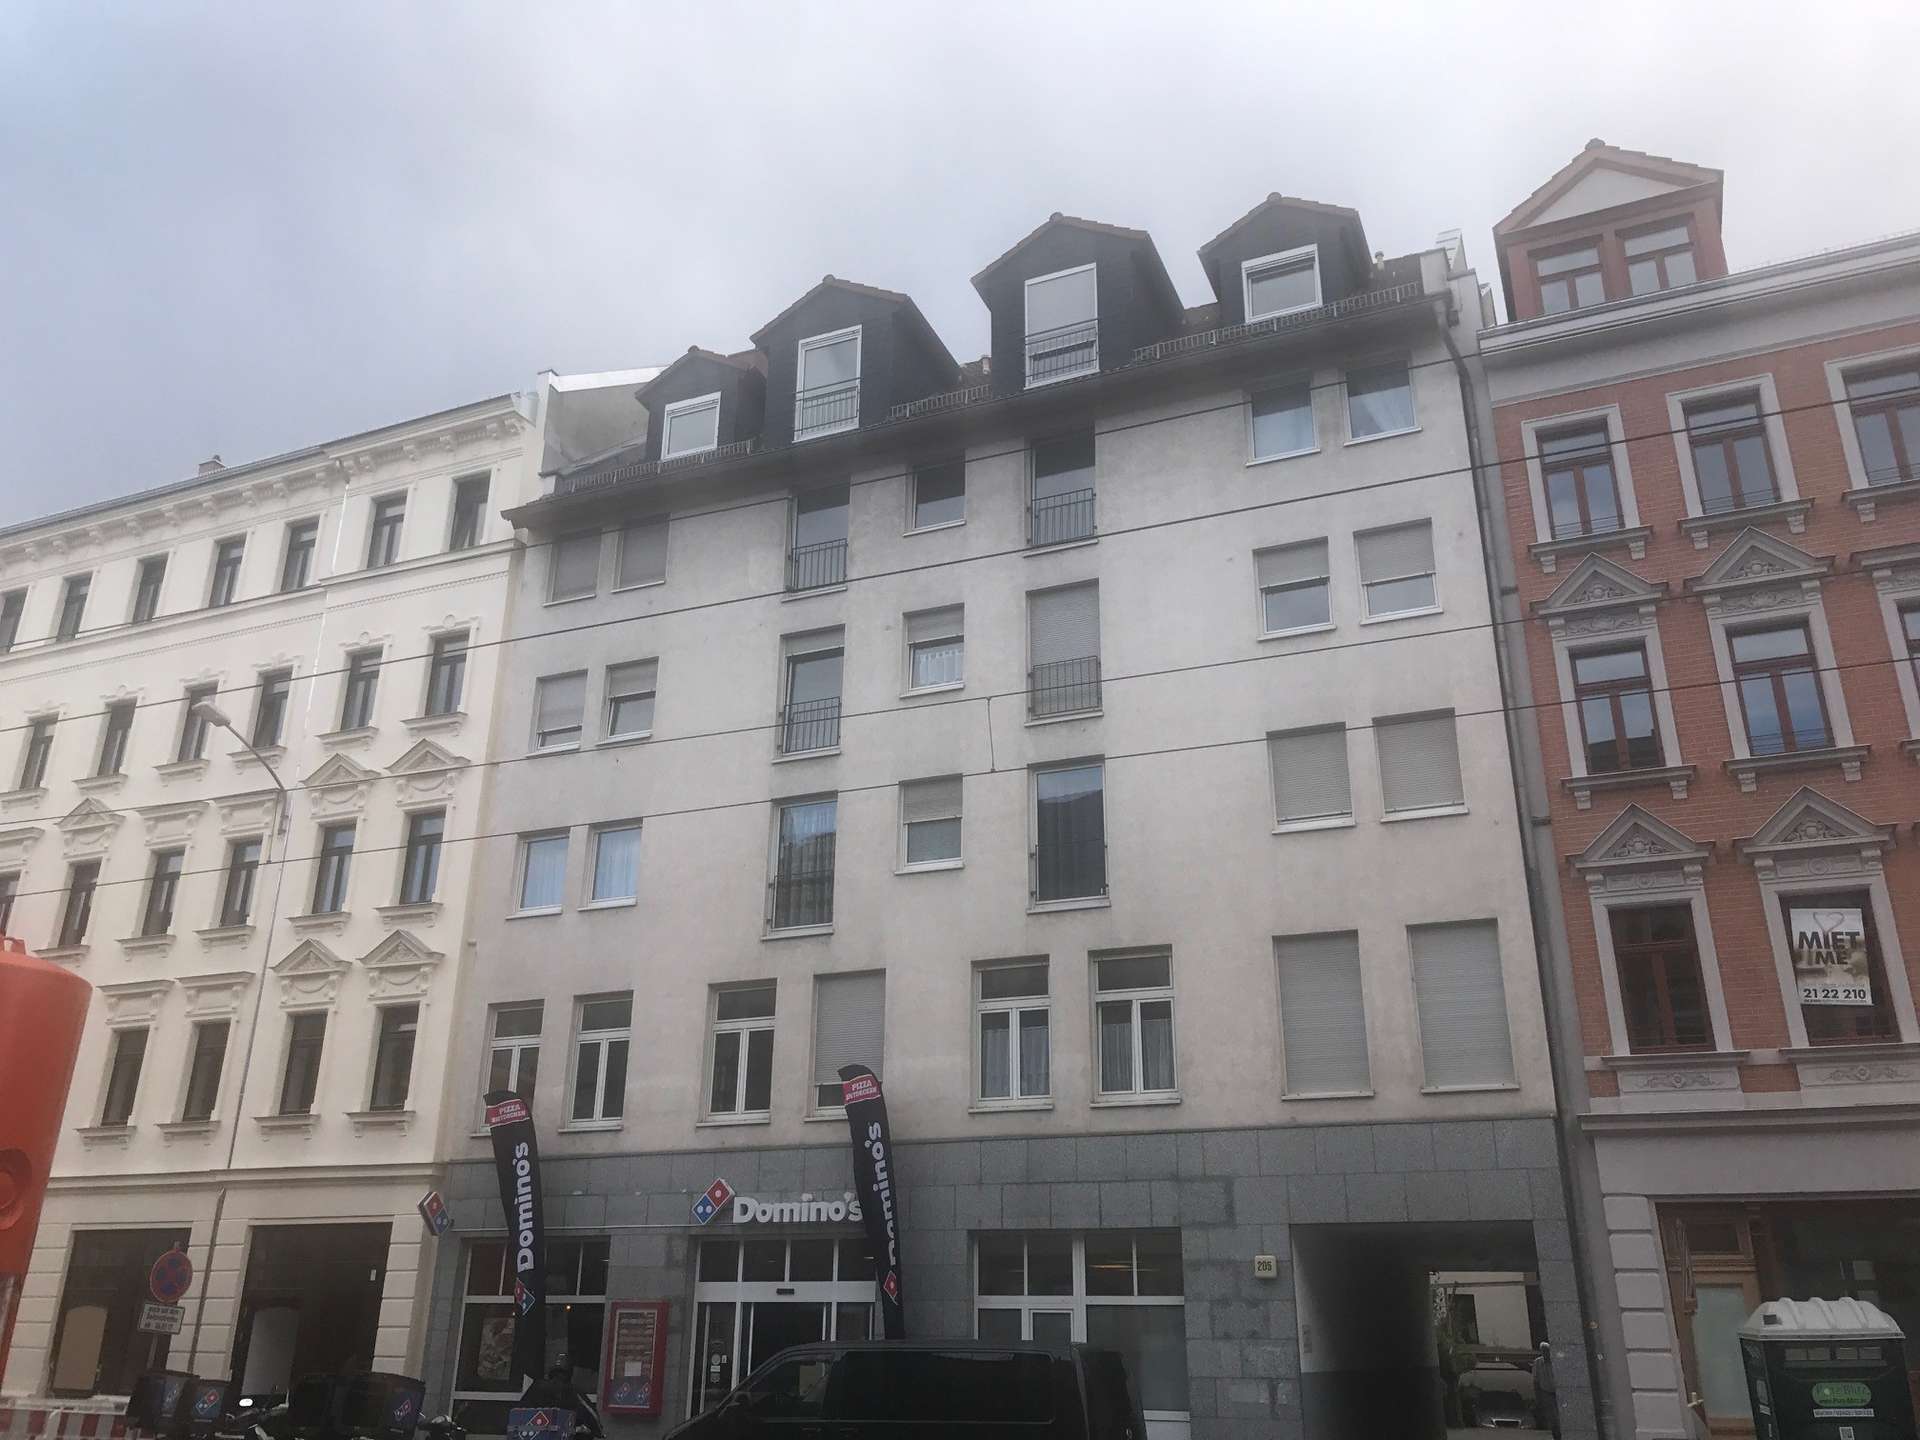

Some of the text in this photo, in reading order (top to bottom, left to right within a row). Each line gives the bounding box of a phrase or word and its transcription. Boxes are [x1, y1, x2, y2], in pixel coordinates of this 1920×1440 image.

[1798, 931, 1861, 950] MIET
[1815, 951, 1849, 965] ME
[1803, 988, 1867, 1000] 21 22 210
[851, 1080, 873, 1091] PIZZA
[512, 1142, 534, 1273] Domino's
[733, 1192, 864, 1224] Domino's
